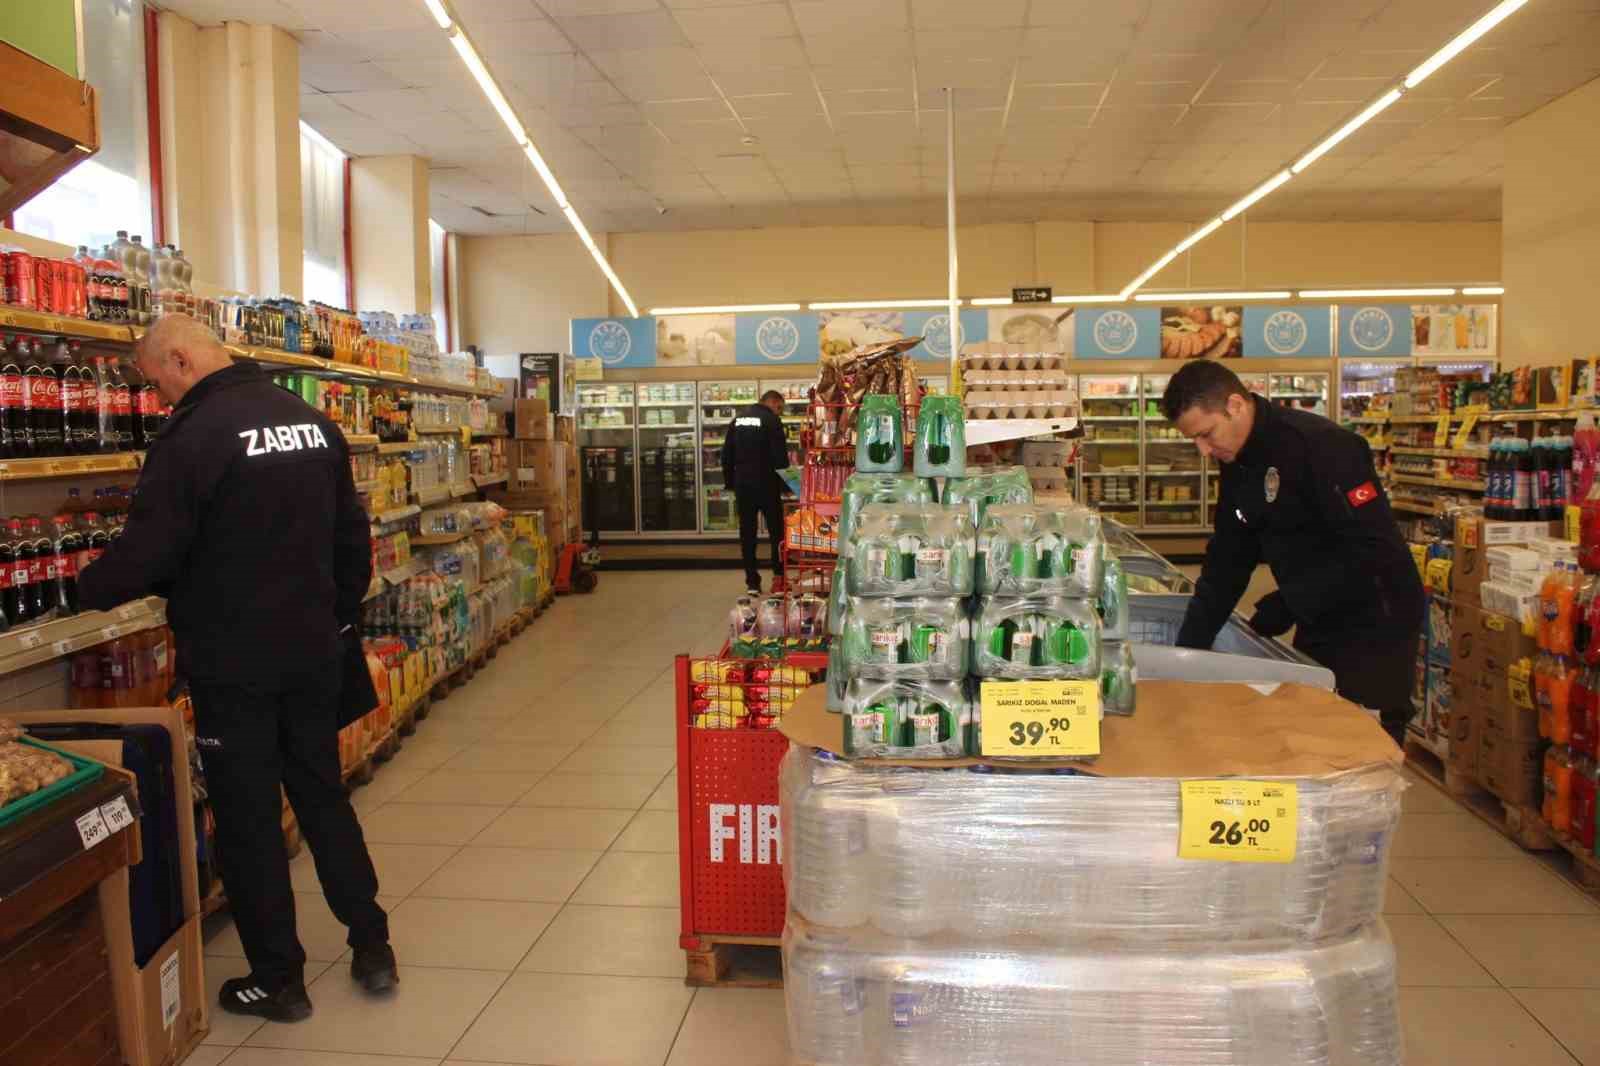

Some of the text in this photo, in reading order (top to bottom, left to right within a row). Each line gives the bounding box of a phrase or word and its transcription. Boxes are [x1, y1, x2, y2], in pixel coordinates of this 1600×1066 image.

[238, 424, 328, 456] ZABITA
[1049, 736, 1060, 745] TL
[1248, 837, 1258, 846] TL
